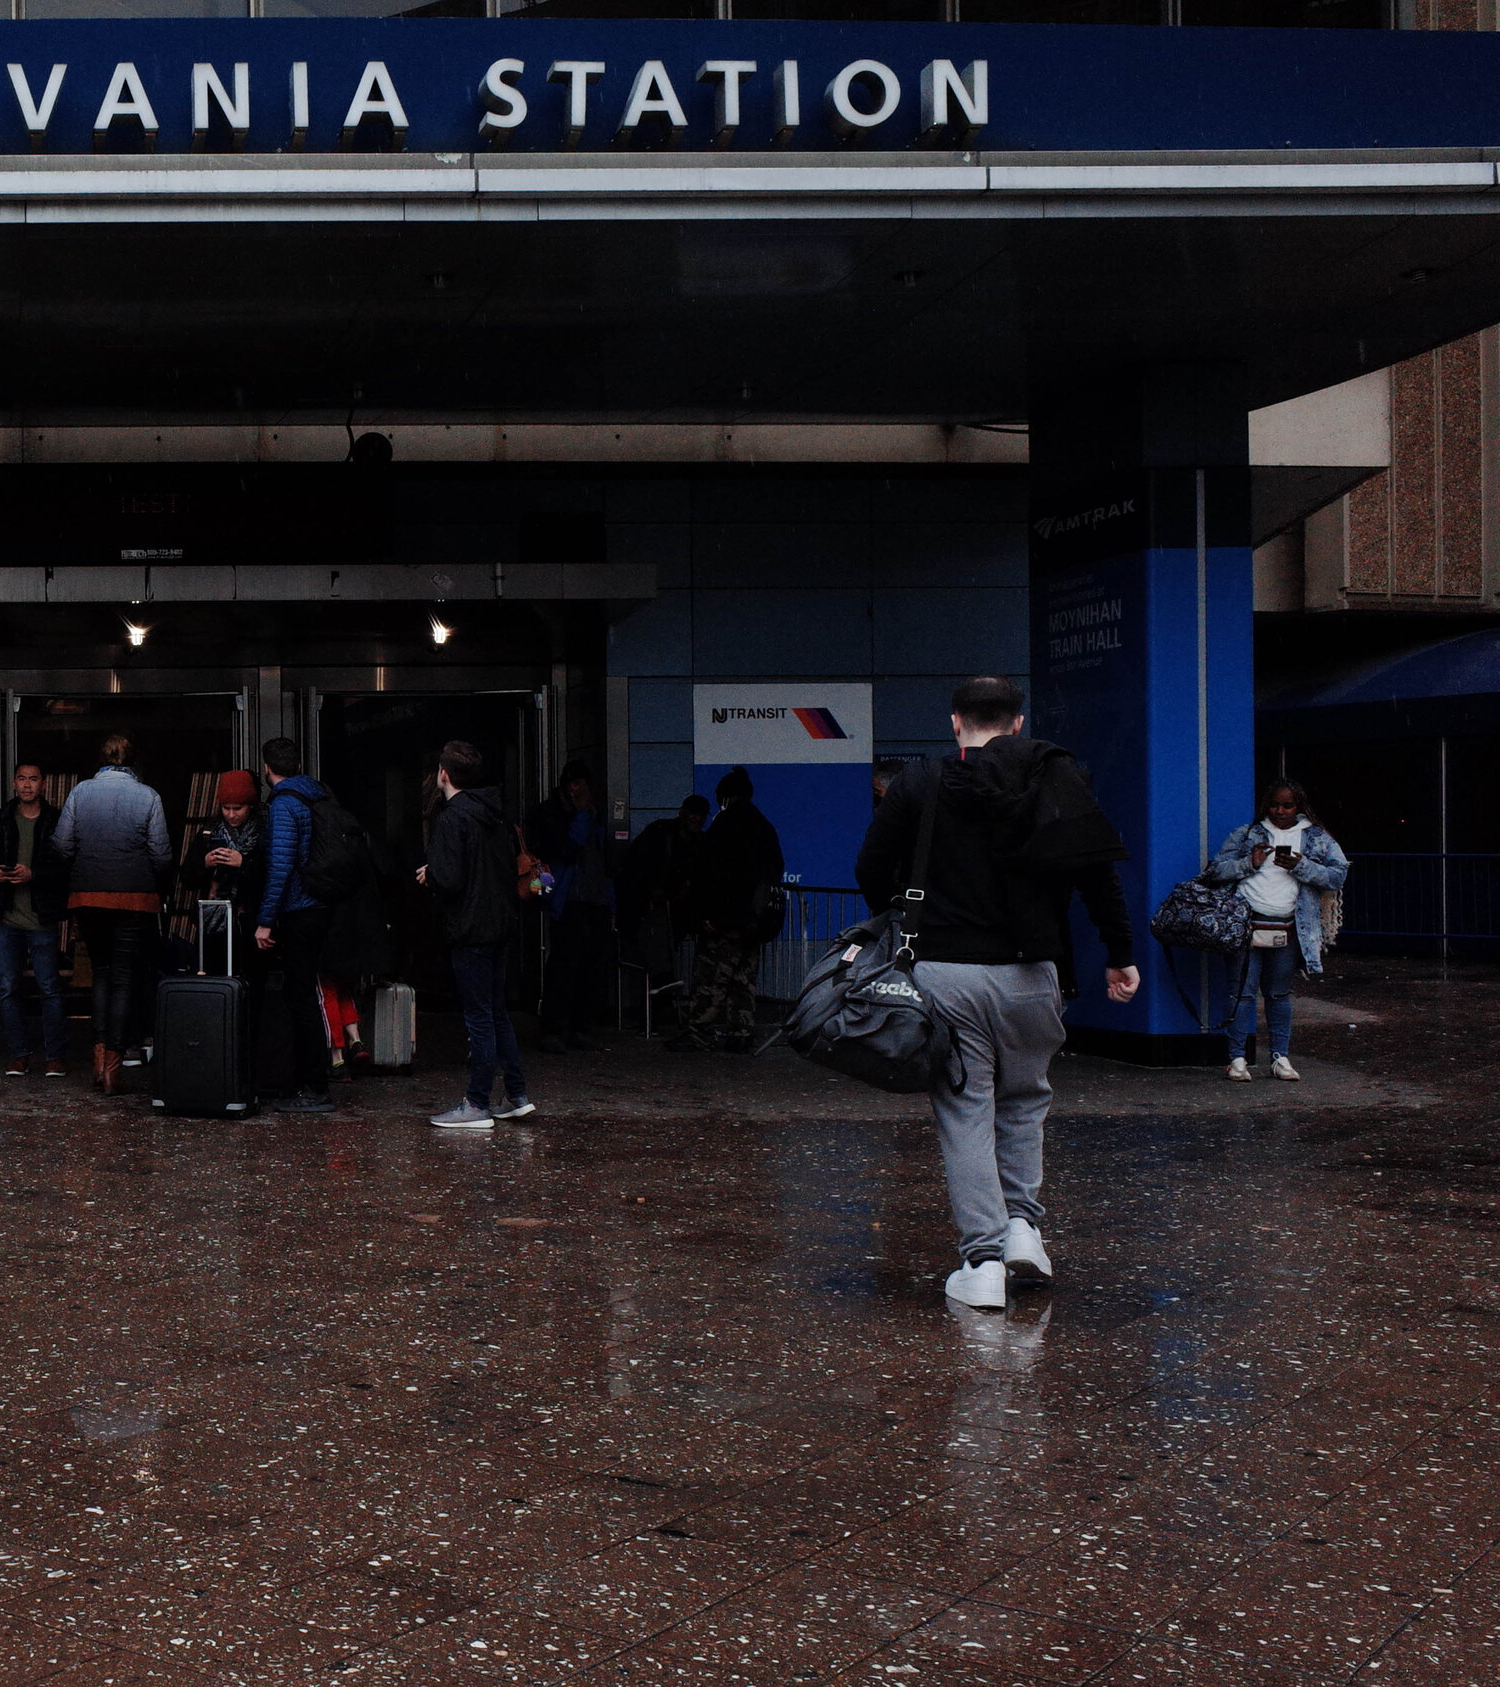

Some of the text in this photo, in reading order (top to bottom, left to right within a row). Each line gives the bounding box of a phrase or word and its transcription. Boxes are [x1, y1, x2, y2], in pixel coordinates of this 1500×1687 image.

[478, 57, 989, 132] STATION
[1054, 498, 1137, 535] AMTRAK
[1048, 598, 1123, 633] MOYNIHAN
[1048, 627, 1123, 660] TRAIN HALL
